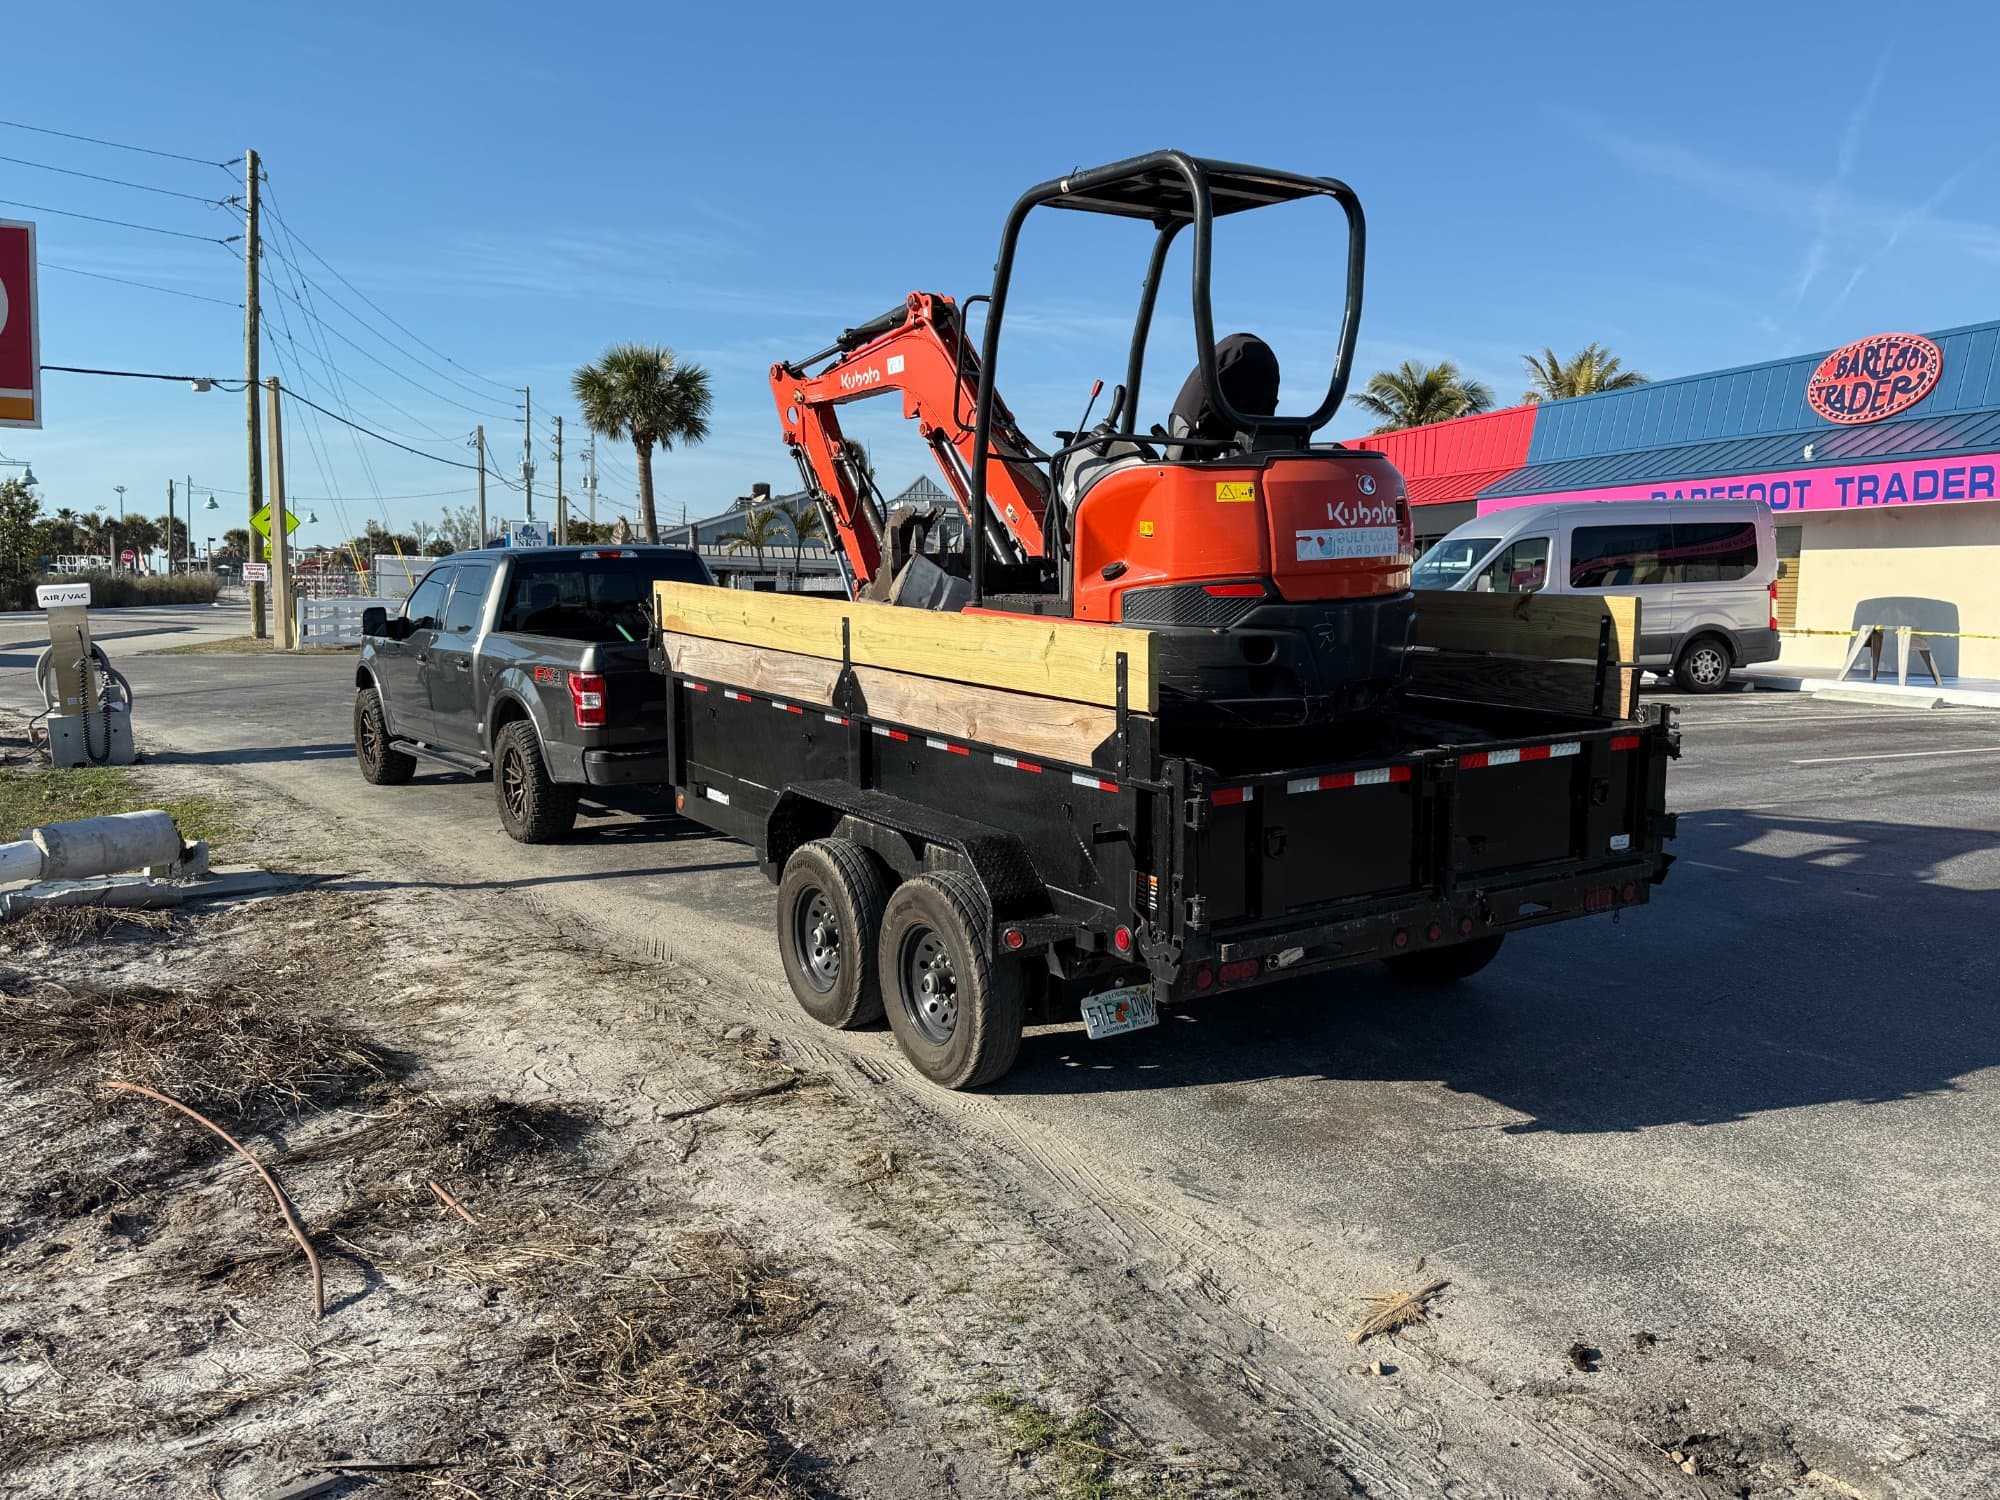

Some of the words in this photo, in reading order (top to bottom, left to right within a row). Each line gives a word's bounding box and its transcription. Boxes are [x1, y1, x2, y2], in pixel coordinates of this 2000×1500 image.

[1834, 342, 1929, 380] BAREFOOT
[840, 365, 880, 390] Kubota
[1815, 371, 1928, 415] TRADER
[1834, 465, 1995, 507] TRADER
[1326, 499, 1397, 527] Kubota
[1336, 543, 1398, 558] HARDWARE
[1337, 531, 1367, 544] GULF
[42, 593, 88, 602] AIR/VAC
[534, 665, 562, 683] FX4
[1086, 1002, 1117, 1029] 51E
